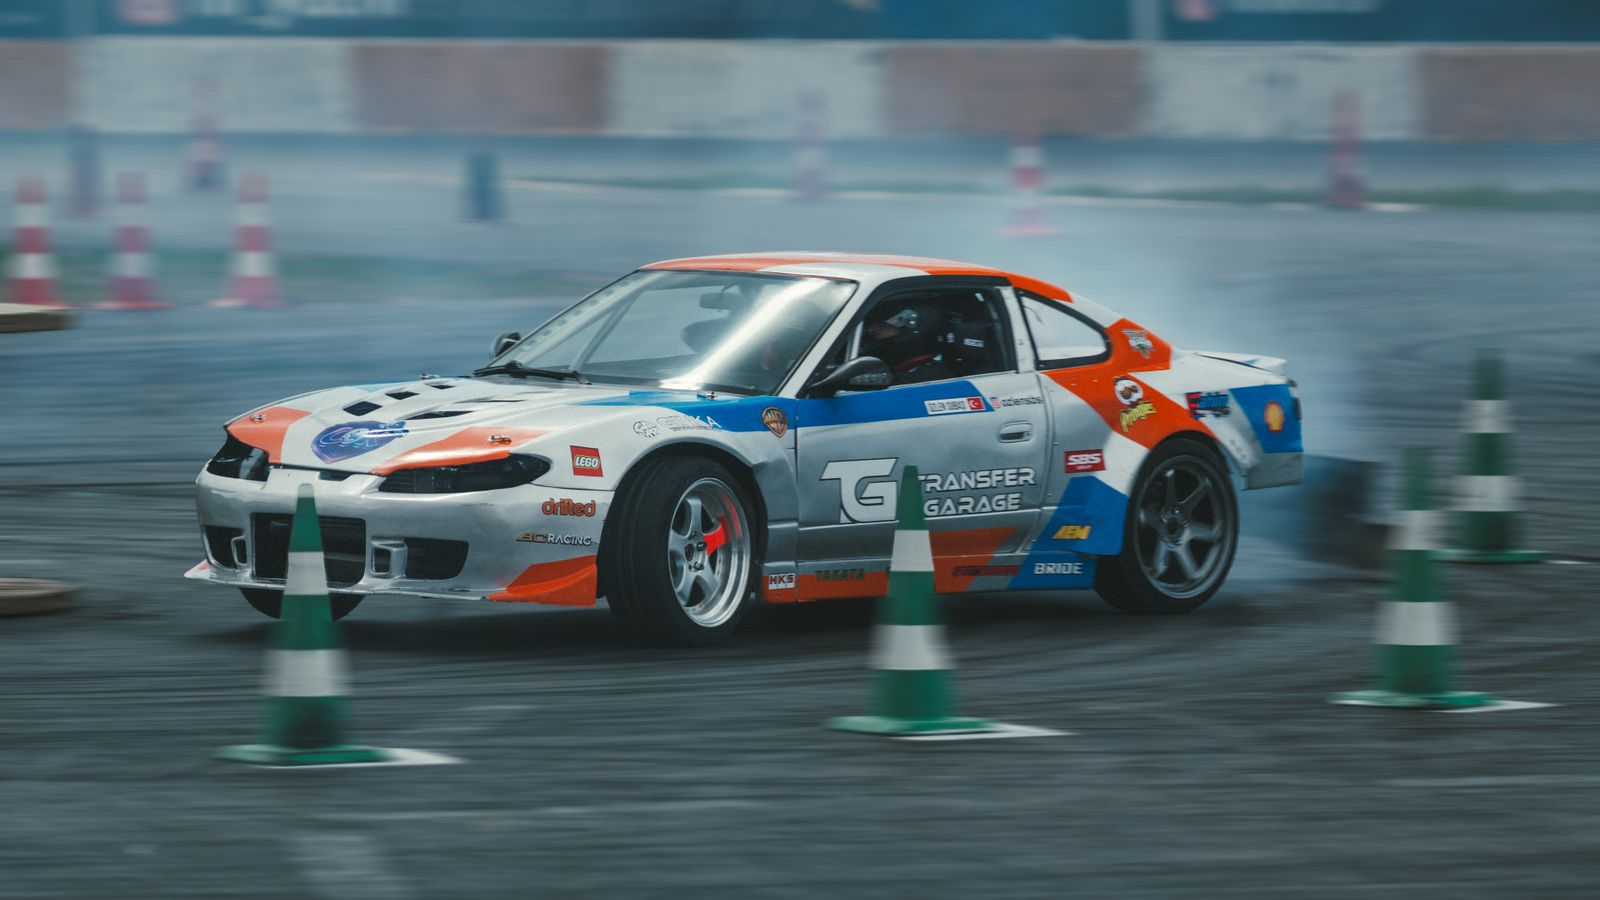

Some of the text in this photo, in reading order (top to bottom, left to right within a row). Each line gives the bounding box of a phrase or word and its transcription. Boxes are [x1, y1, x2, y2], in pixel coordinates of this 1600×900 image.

[574, 455, 599, 469] LEGO
[1067, 453, 1102, 466] SBS
[820, 457, 899, 524] TG
[541, 497, 597, 518] drifted
[923, 492, 1022, 516] GARAGE
[547, 533, 592, 546] RACING
[1051, 525, 1092, 540] AEM
[815, 567, 866, 582] TAKATA
[1033, 562, 1084, 576] BRIDE
[769, 574, 794, 586] HKS
